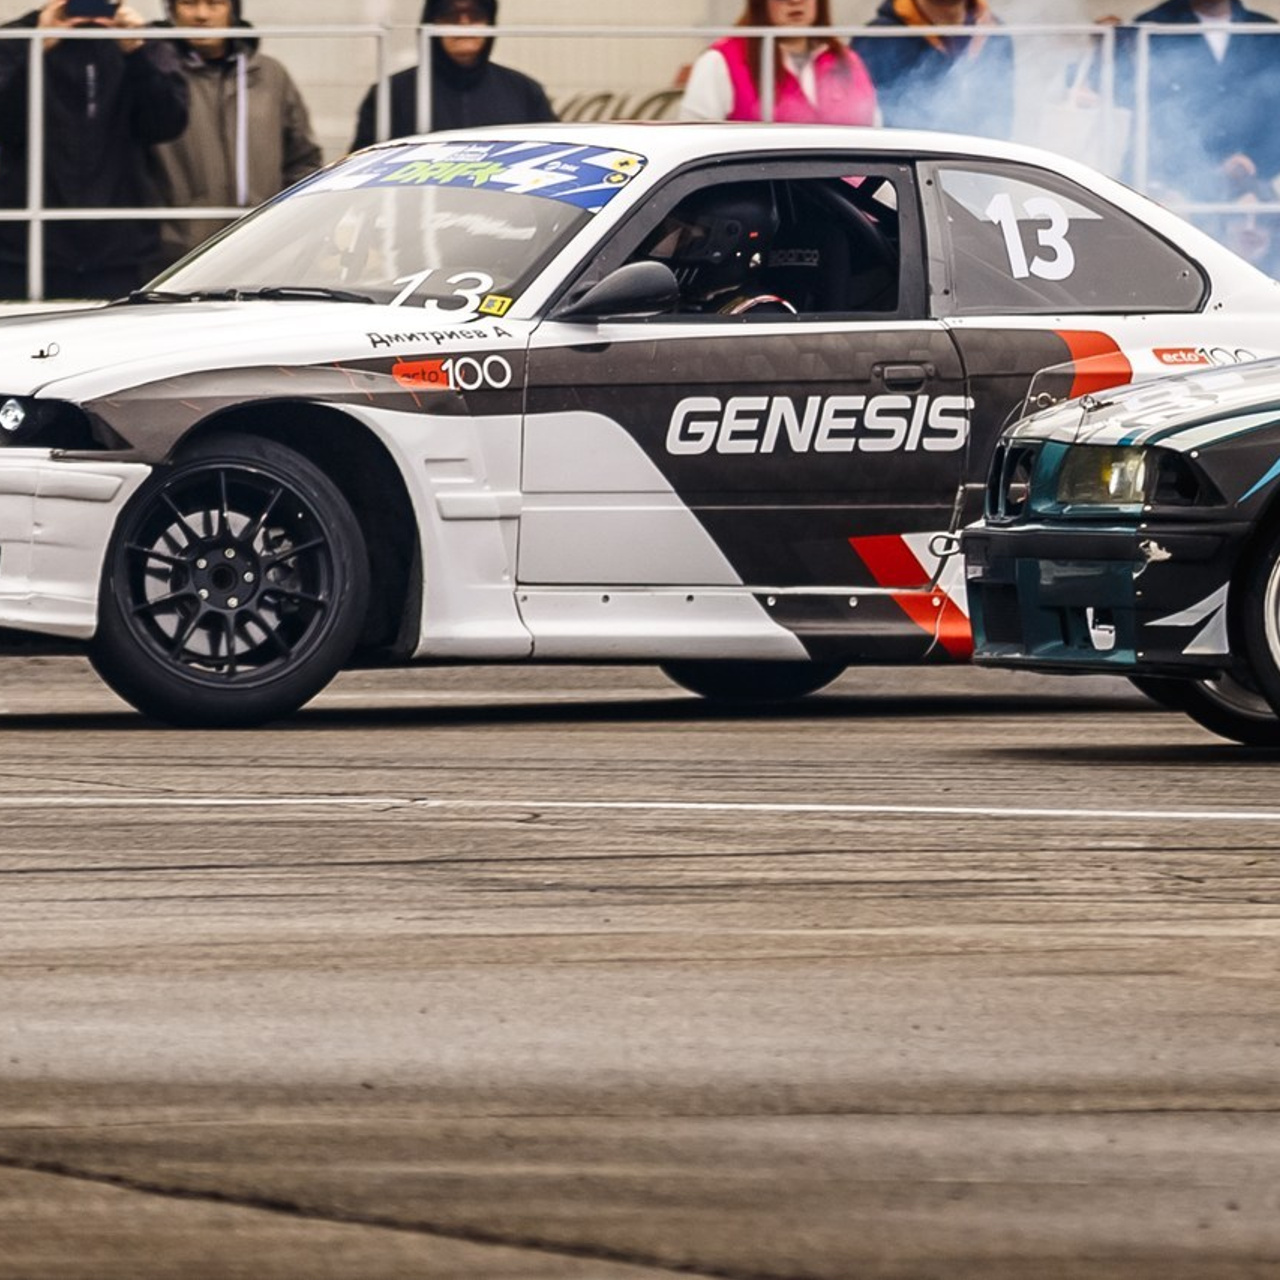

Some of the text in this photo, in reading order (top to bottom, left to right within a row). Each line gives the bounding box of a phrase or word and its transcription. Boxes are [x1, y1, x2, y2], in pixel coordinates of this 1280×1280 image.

[384, 160, 508, 187] DRIFT
[985, 192, 1075, 280] 13
[390, 269, 494, 323] 13
[366, 329, 488, 348] Дмитриев
[666, 395, 975, 455] GENESIS
